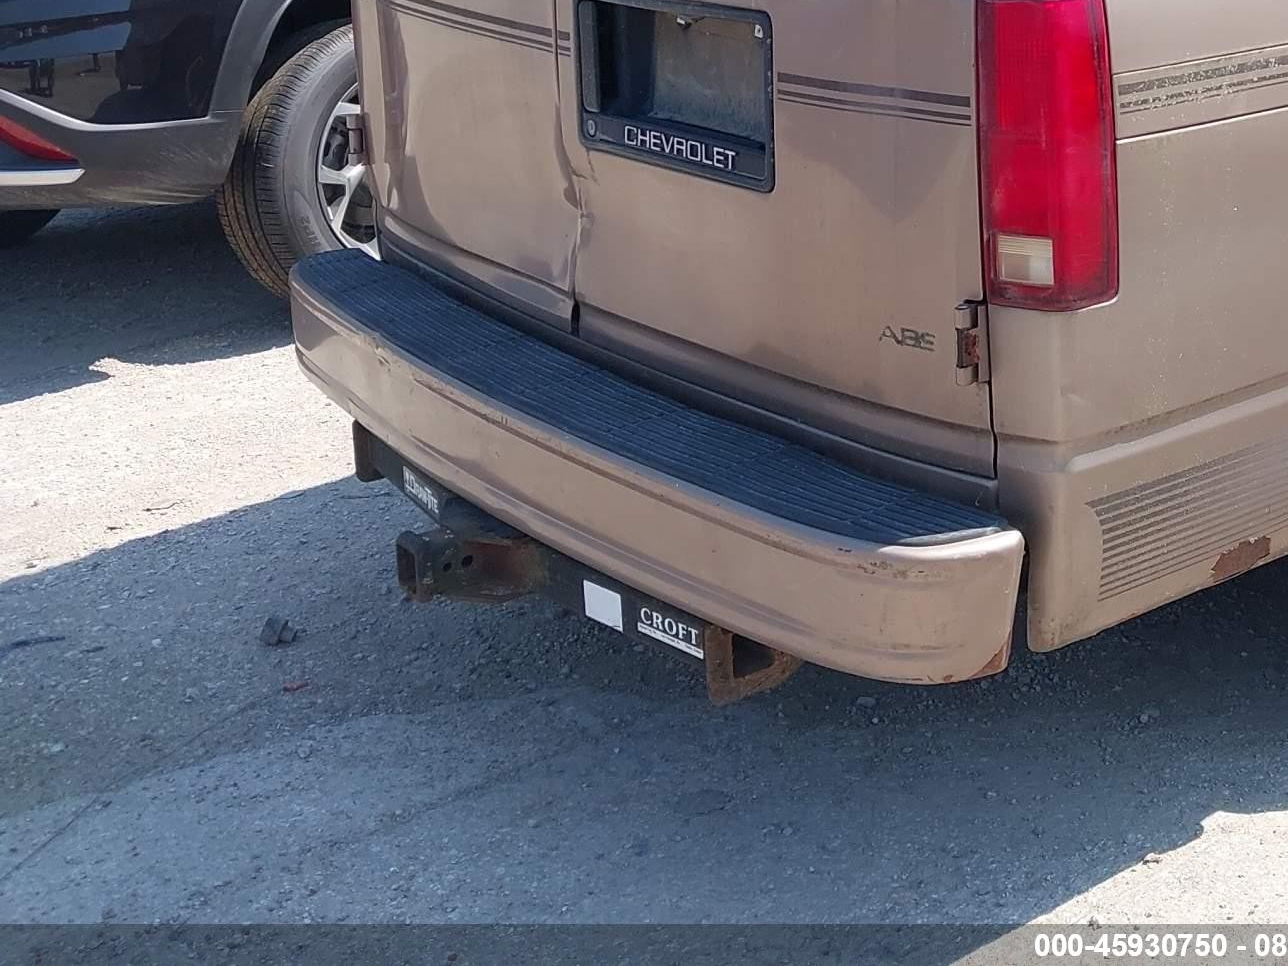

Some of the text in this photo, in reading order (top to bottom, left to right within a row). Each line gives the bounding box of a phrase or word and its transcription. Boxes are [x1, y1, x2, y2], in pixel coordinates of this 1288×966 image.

[623, 125, 737, 171] CHEVROLET
[878, 325, 936, 352] ABS
[640, 607, 699, 645] CROFT
